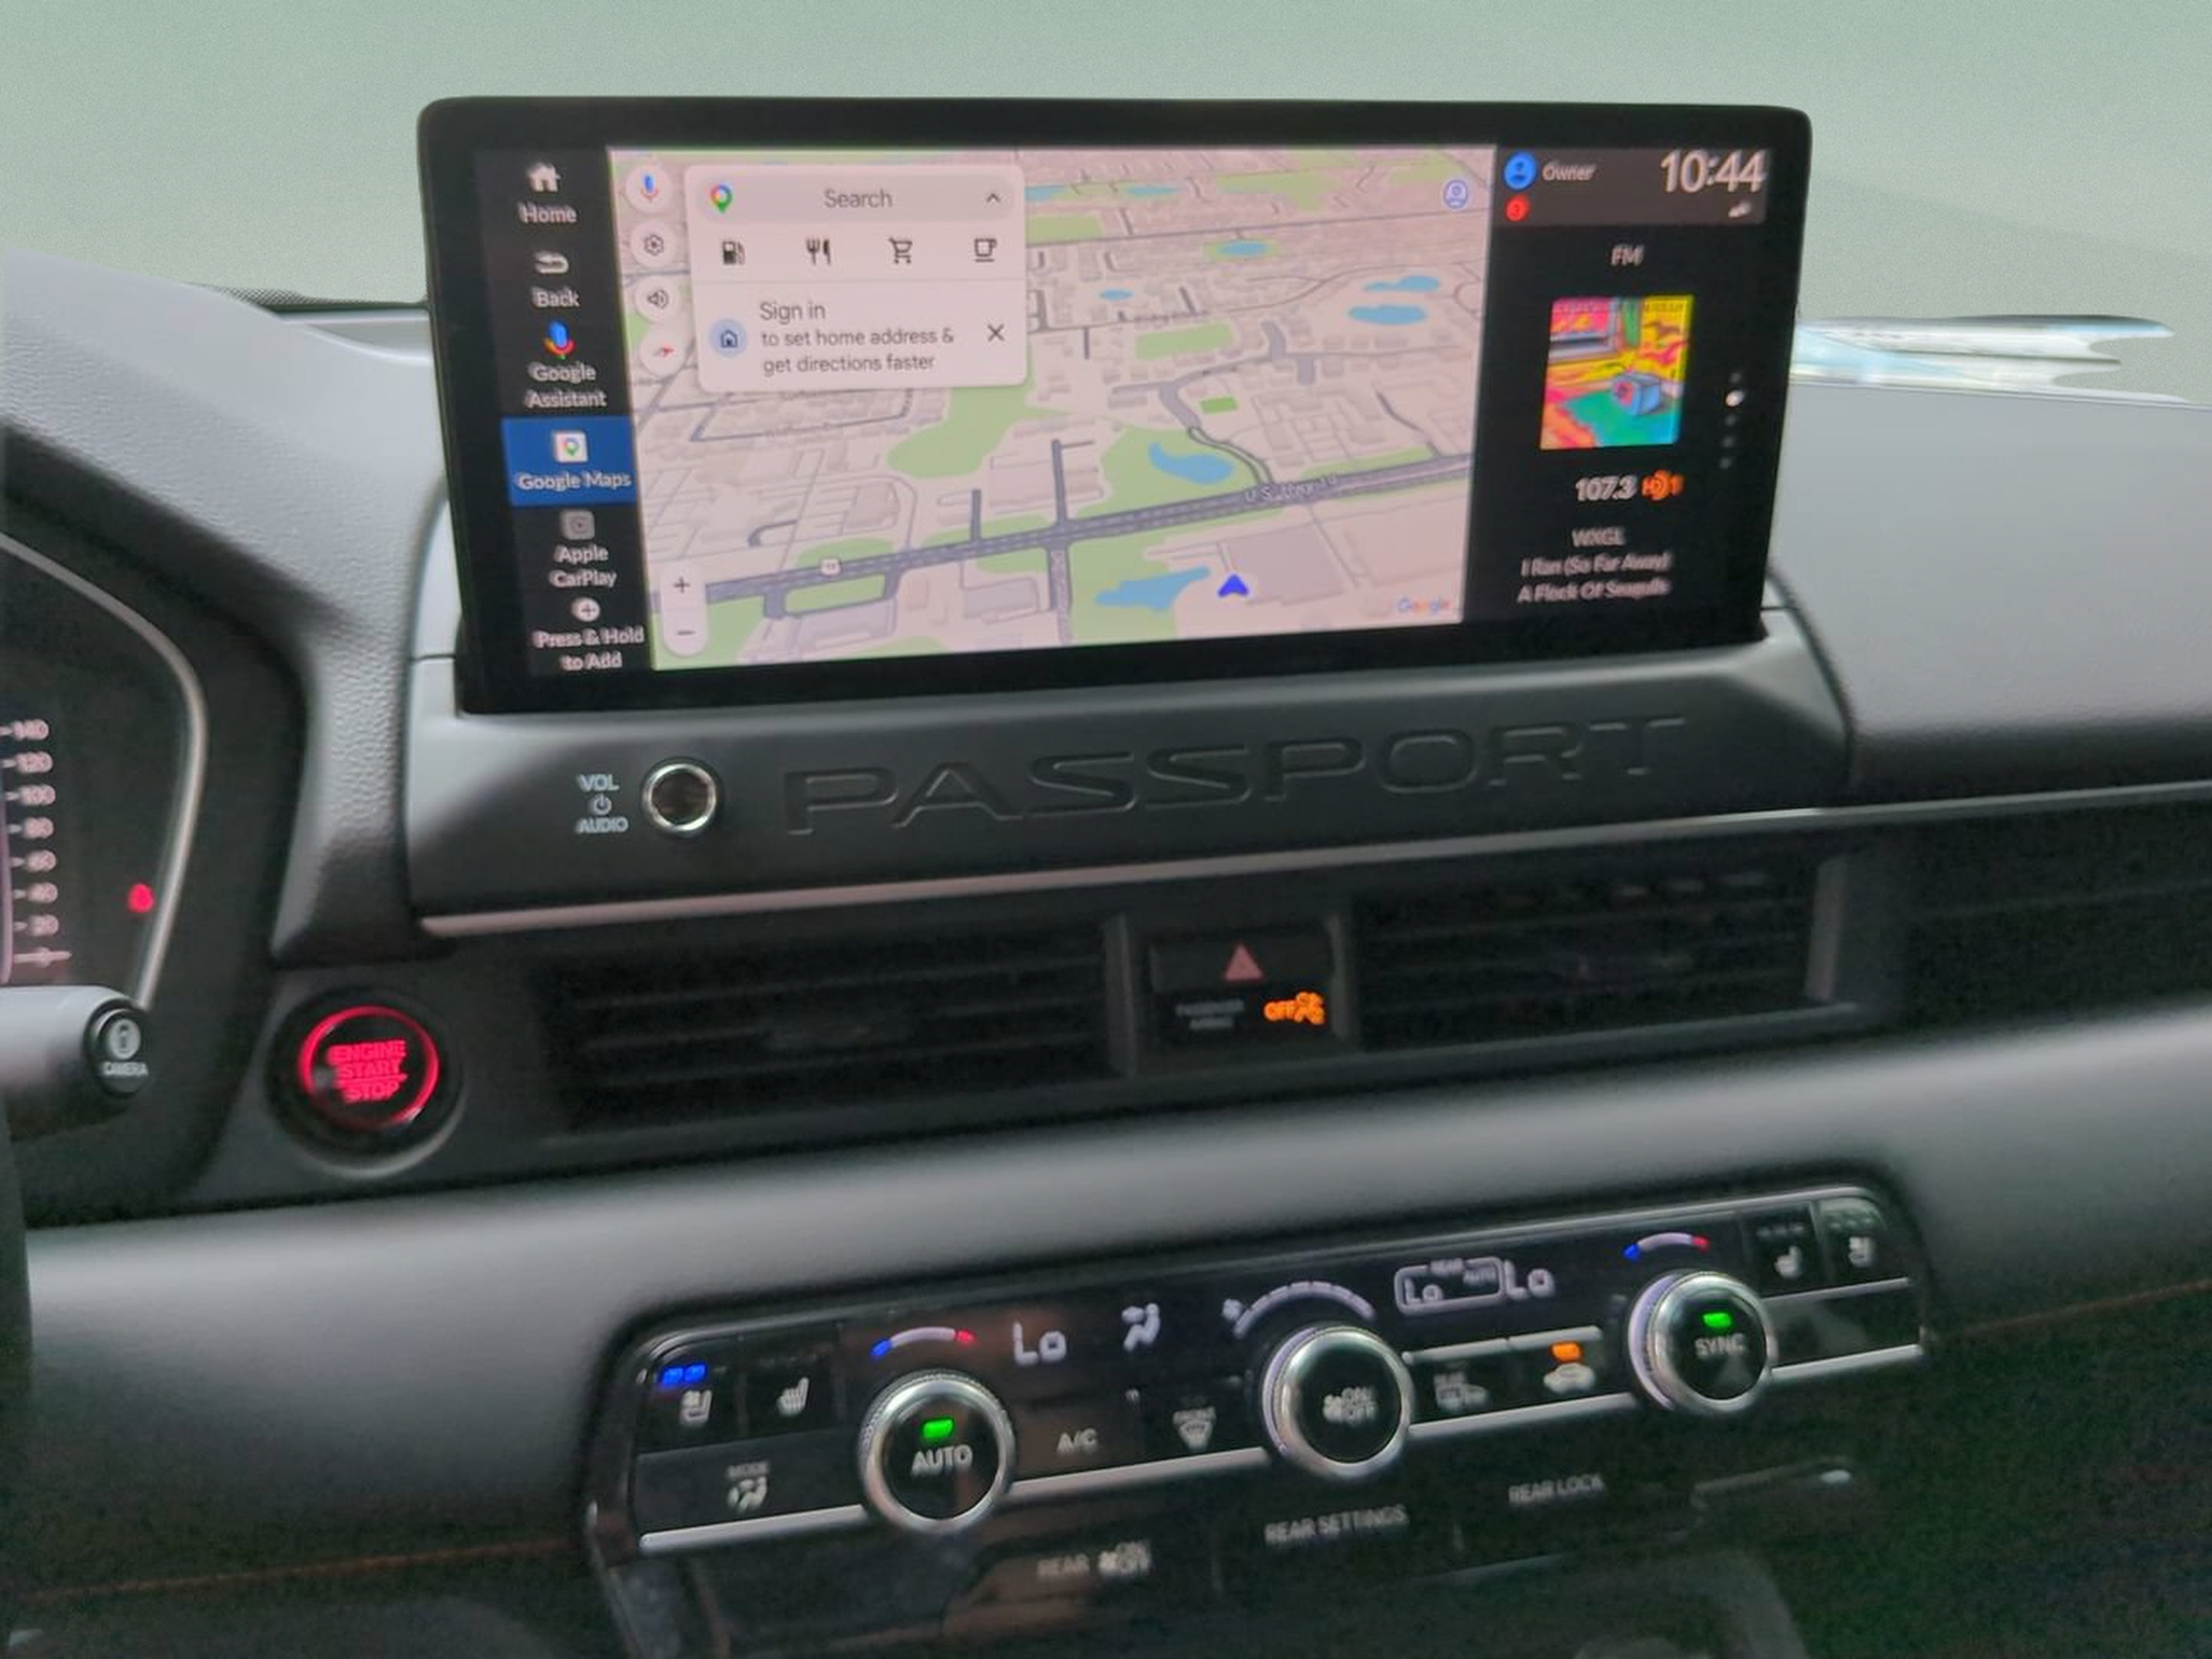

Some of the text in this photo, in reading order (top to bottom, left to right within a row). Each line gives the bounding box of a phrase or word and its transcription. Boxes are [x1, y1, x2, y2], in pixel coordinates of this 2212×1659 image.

[1542, 161, 1596, 181] Owner
[1661, 149, 1767, 193] 10:44
[824, 189, 893, 208] Search
[518, 202, 578, 224] Home
[1611, 244, 1644, 267] FM
[531, 289, 580, 307] Back
[760, 302, 825, 325] Sign in
[762, 328, 954, 346] to set home address &
[528, 362, 596, 384] Google
[763, 353, 935, 374] get directions faster
[524, 389, 607, 408] Assistant
[517, 472, 632, 492] Google Maps
[1575, 475, 1637, 502] 107.3
[556, 545, 608, 565] Apple
[1520, 557, 1530, 576] I
[551, 571, 617, 589] CarPlay
[1517, 583, 1532, 603] A
[535, 627, 644, 648] Press & Hold
[560, 652, 622, 670] to Add
[578, 773, 620, 792] VOL
[783, 716, 1684, 835] PASSPORT
[575, 816, 628, 834] AUDIO
[327, 1039, 407, 1065] ENGINE
[337, 1059, 402, 1081] START
[342, 1081, 401, 1104] STOP
[1694, 1333, 1746, 1358] SYNC
[1056, 1428, 1099, 1455] A/C
[911, 1444, 973, 1477] AUTO
[1508, 1472, 1604, 1505] REAR LOCK
[1264, 1504, 1409, 1545] REAR SETTINGS
[1037, 1553, 1090, 1579] REAR
